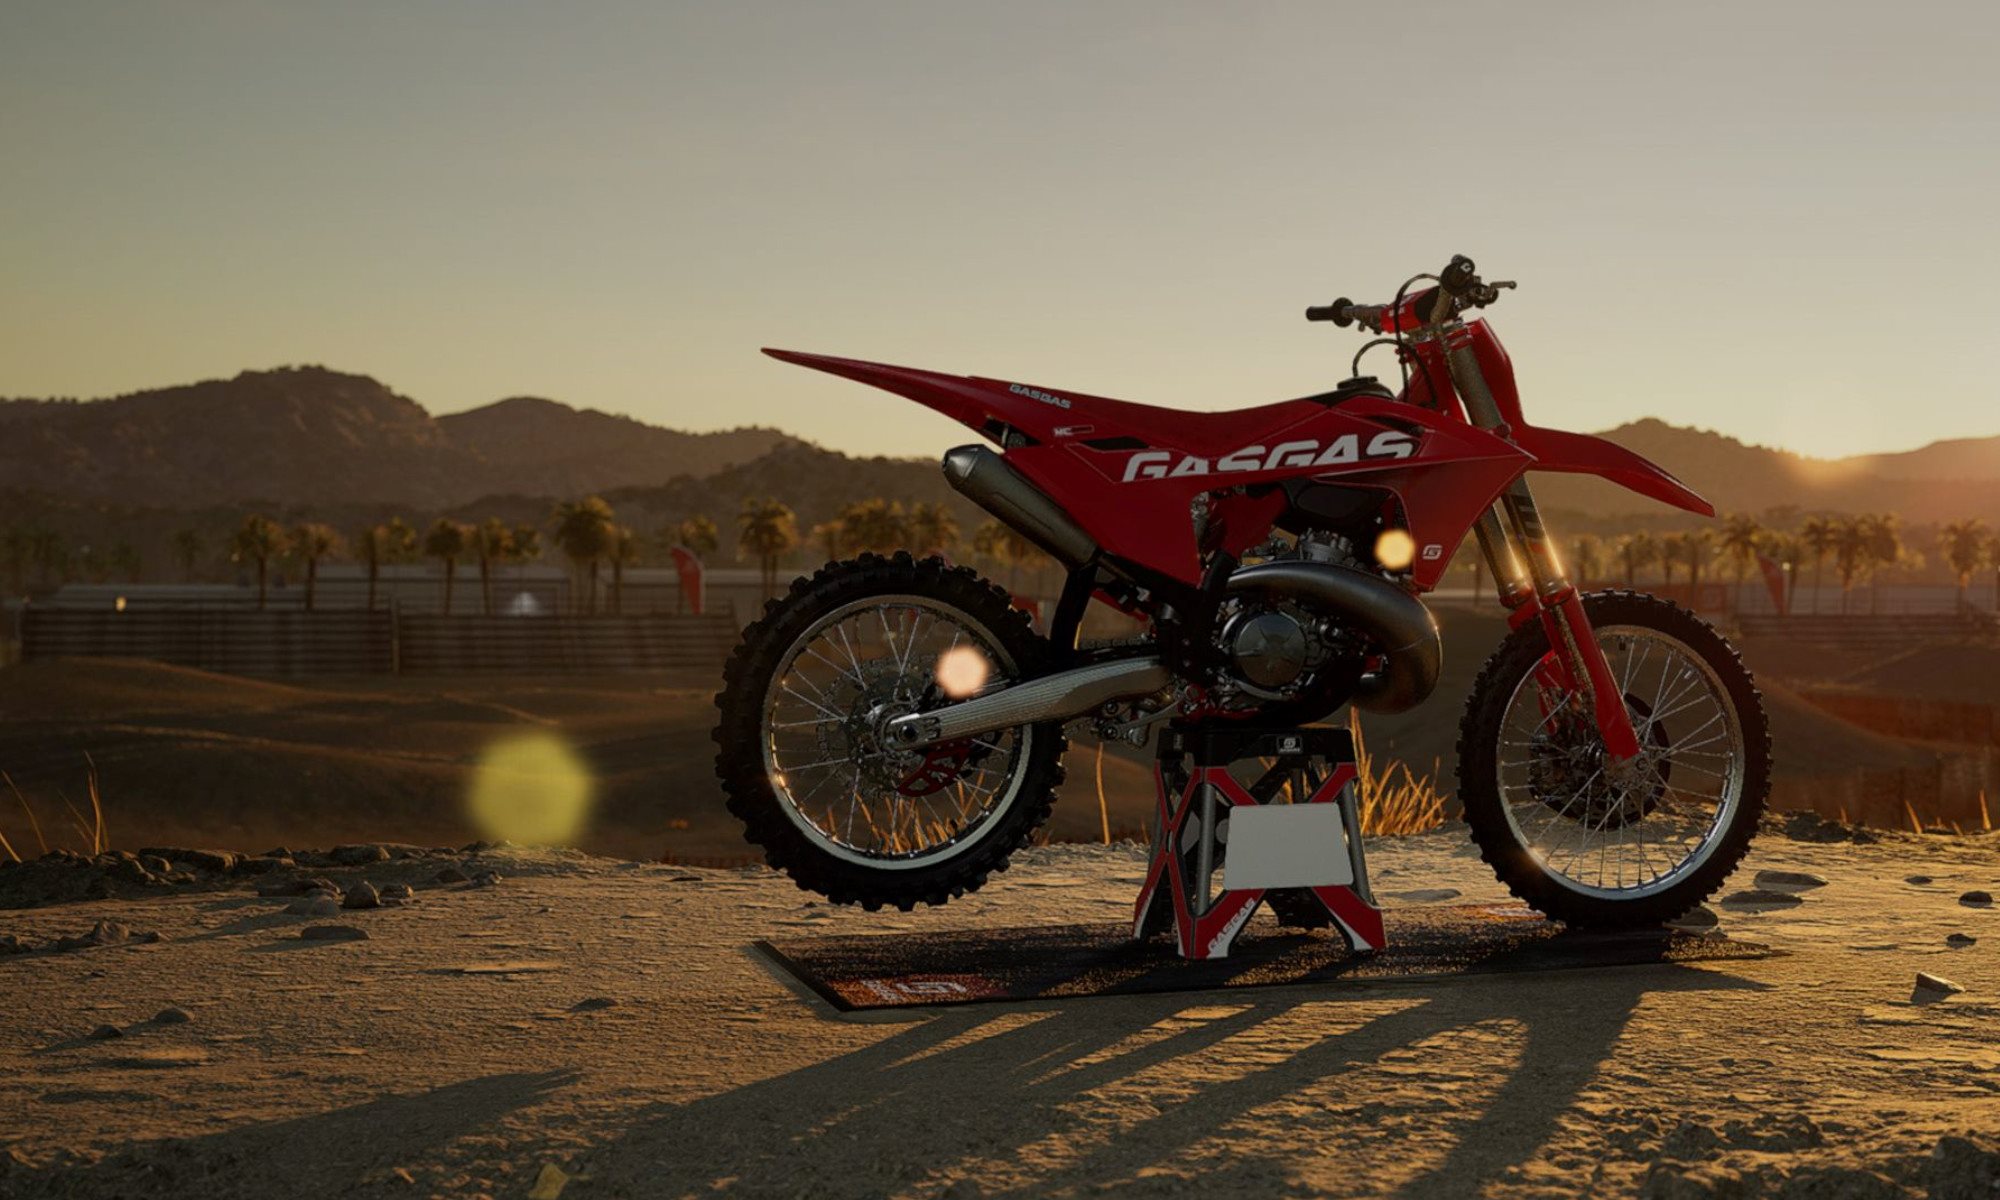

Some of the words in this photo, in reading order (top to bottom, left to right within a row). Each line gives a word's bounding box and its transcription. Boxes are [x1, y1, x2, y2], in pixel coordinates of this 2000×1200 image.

[1008, 383, 1072, 409] GASGAS
[1122, 430, 1415, 483] GASGAS
[1206, 897, 1256, 956] GASGAS
